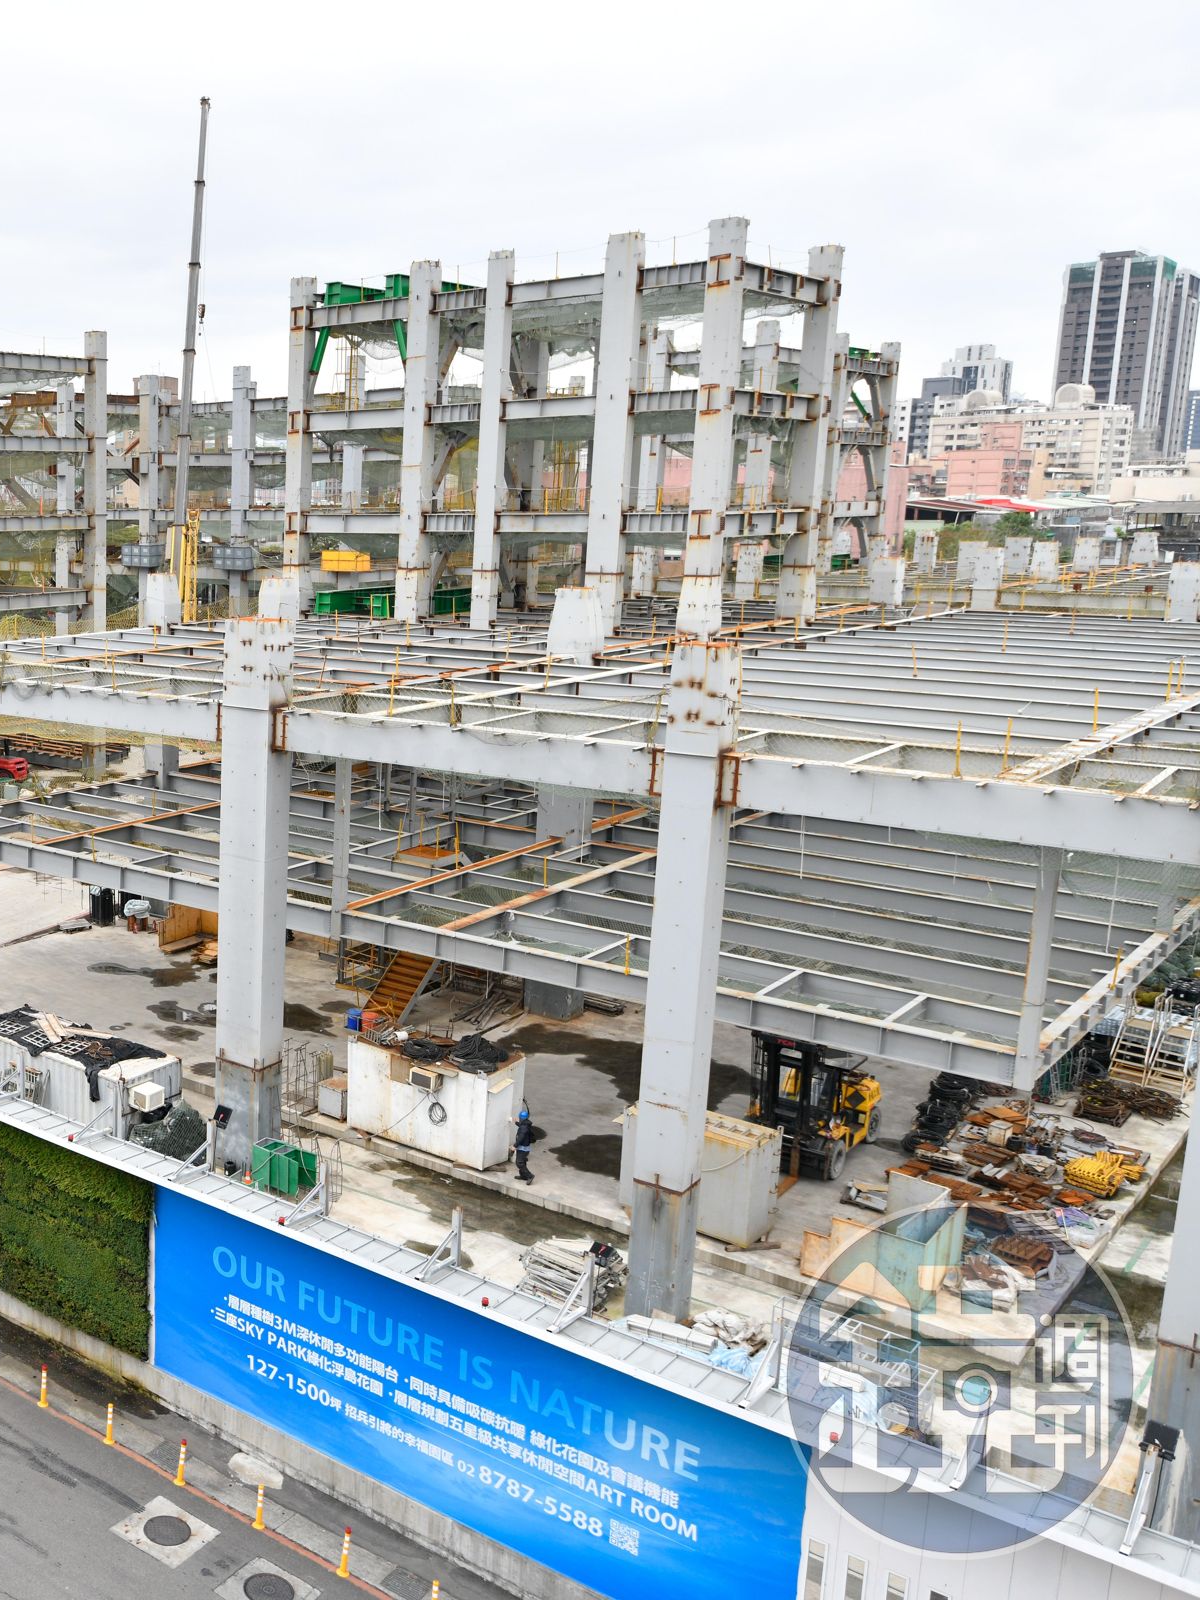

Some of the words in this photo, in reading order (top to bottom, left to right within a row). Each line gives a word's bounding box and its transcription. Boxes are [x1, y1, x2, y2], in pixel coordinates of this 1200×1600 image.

[212, 1246, 286, 1303] OUR
[298, 1279, 444, 1372] FUTURE
[458, 1348, 494, 1391] IS
[509, 1369, 701, 1483] NATURE
[457, 1459, 476, 1478] 02
[478, 1465, 604, 1538] 8787-5588
[630, 1496, 698, 1543] ROOM
